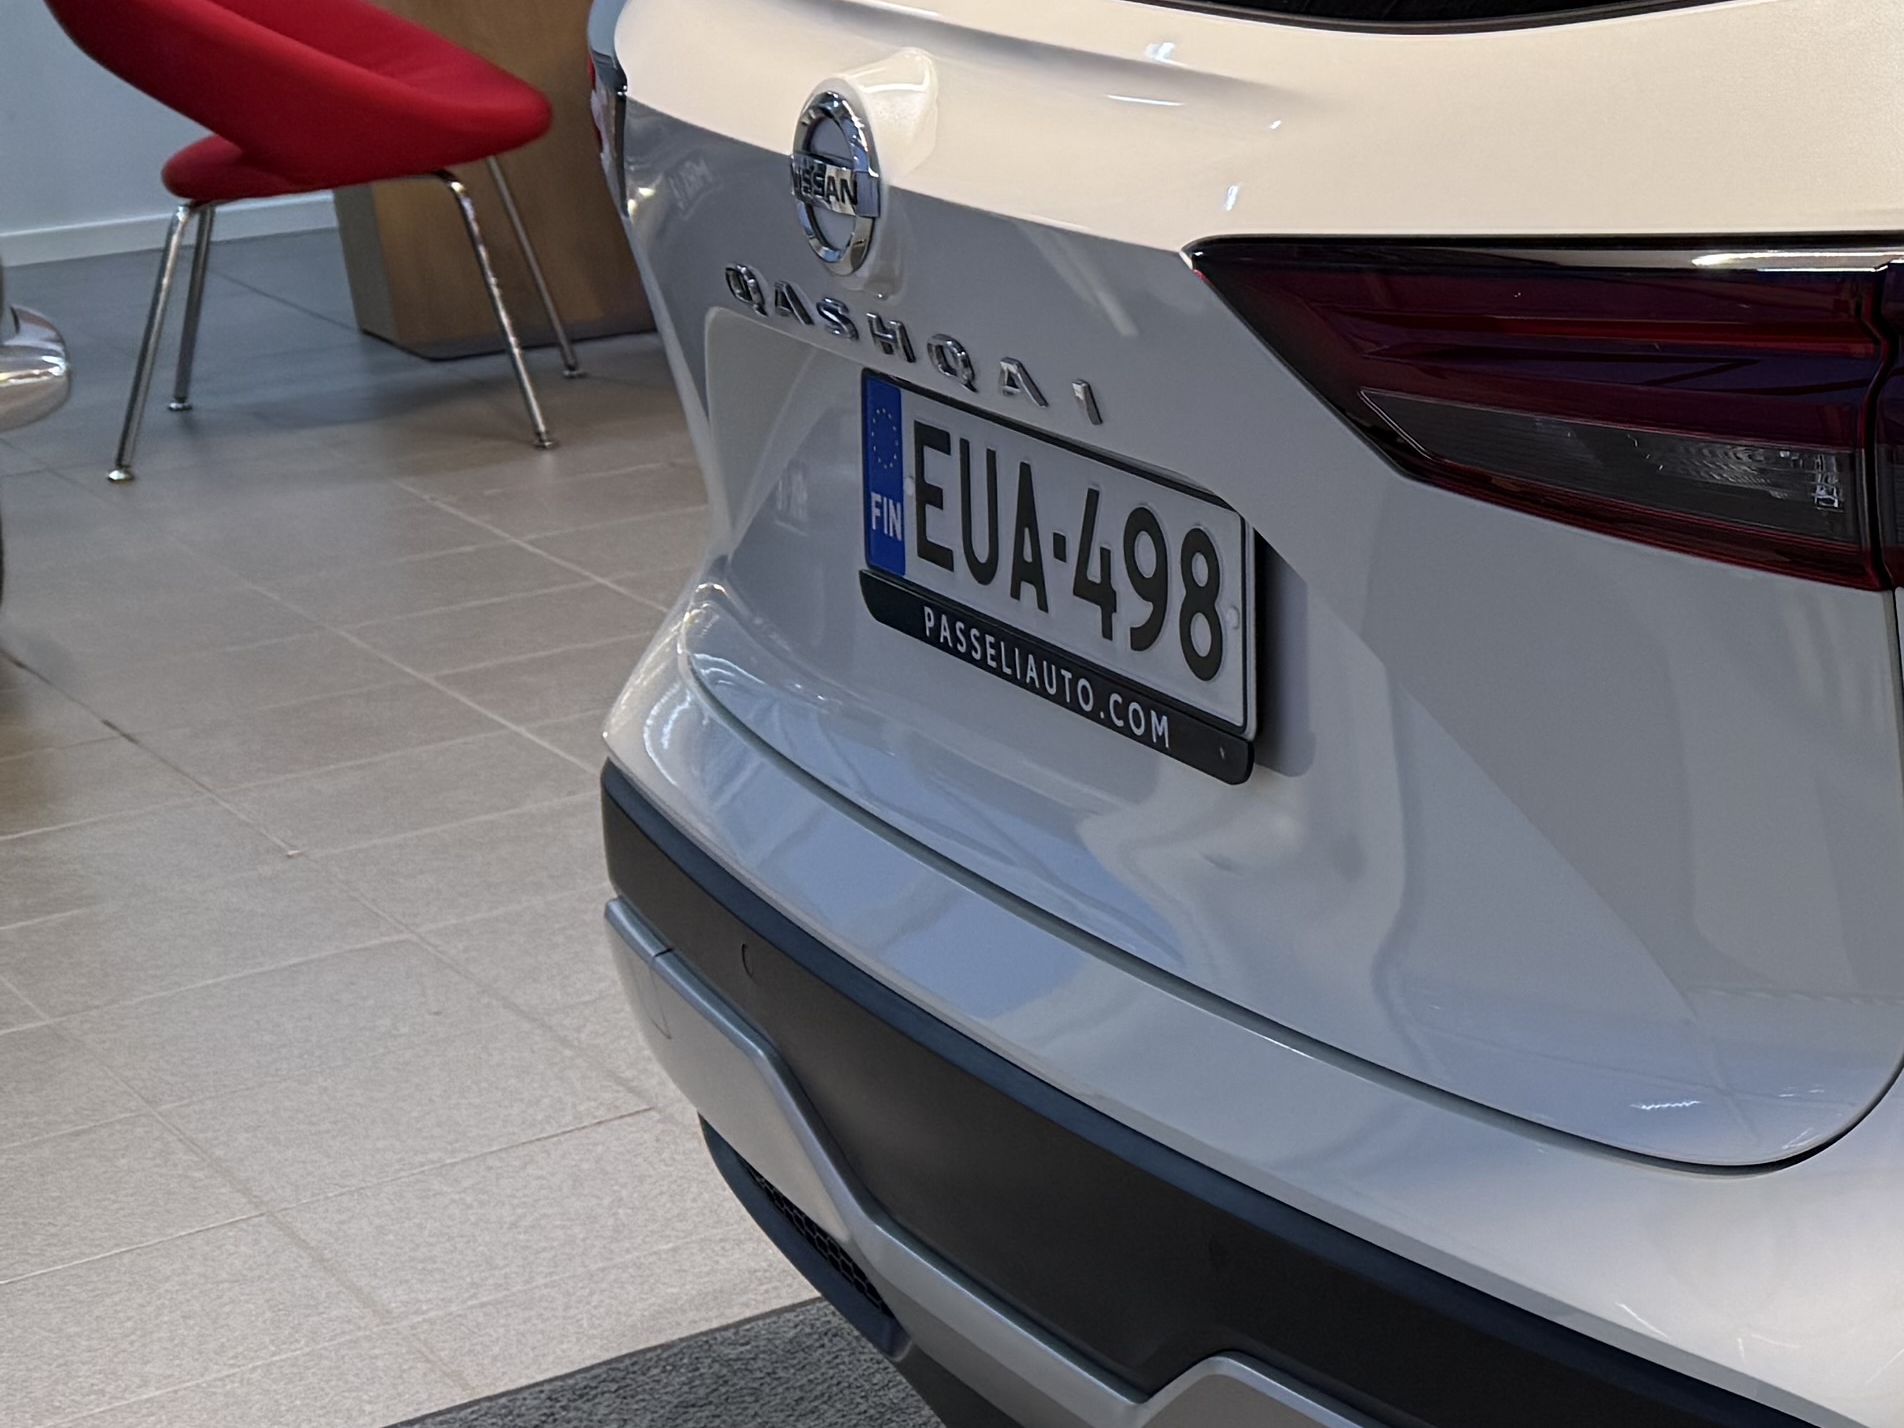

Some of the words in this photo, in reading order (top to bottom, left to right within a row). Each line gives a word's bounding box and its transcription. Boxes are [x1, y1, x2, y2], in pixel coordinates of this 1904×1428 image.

[725, 262, 1103, 426] QASHQAI
[869, 491, 903, 541] FIN
[913, 419, 1224, 682] EUA-498
[923, 605, 1170, 749] PASSELIAUTO.COM
